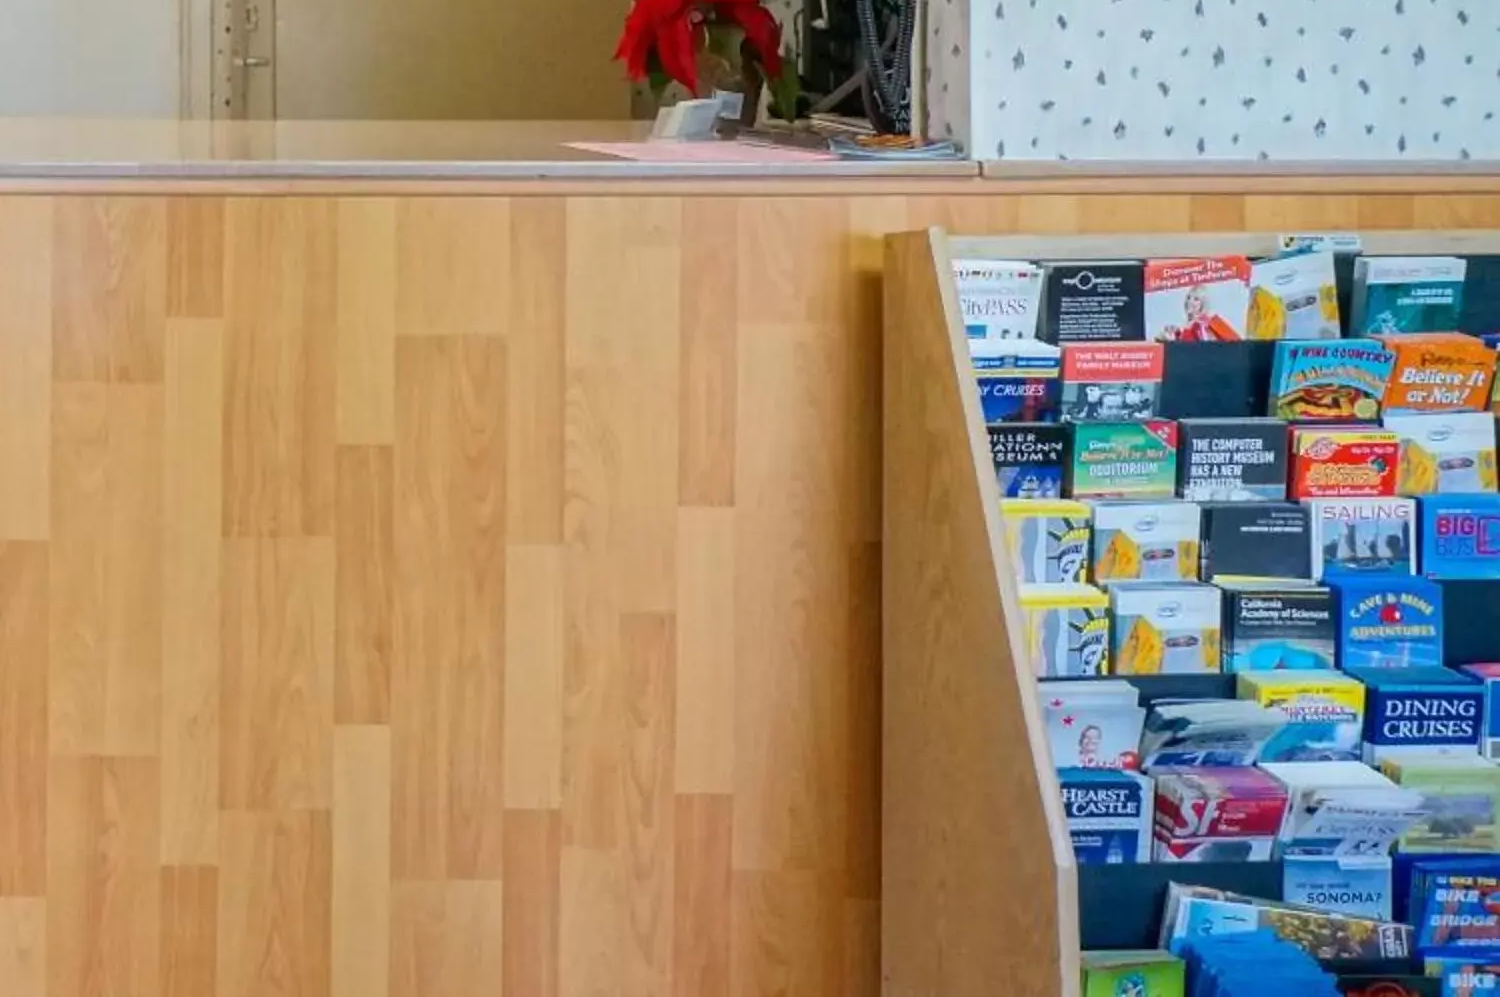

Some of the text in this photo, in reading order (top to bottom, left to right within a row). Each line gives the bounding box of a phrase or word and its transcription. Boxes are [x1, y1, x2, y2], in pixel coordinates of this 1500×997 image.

[1401, 367, 1463, 385] Believe
[1465, 369, 1486, 386] It
[993, 384, 1045, 397] CRUISES
[1406, 388, 1472, 405] or Not!
[993, 433, 1037, 443] ILLER
[1192, 438, 1263, 451] THE COMPUTER
[1191, 451, 1275, 464] HISTORY MUSEUM
[1190, 465, 1243, 477] HAS A NEW
[1323, 504, 1411, 521] SAILING
[1436, 515, 1476, 536] BIG
[1241, 598, 1283, 608] California
[1349, 594, 1383, 619] CAVE
[1241, 609, 1280, 620] Academy
[1281, 609, 1291, 618] of
[1350, 624, 1436, 638] ADVENTURES
[1384, 700, 1477, 717] DINING
[1383, 720, 1474, 739] CRUISES
[1061, 788, 1130, 802] HEARST
[1071, 801, 1139, 816] CASTLE
[1306, 892, 1382, 905] SONOMA?
[1435, 888, 1480, 903] BIKE
[1448, 973, 1496, 989] BIKE
